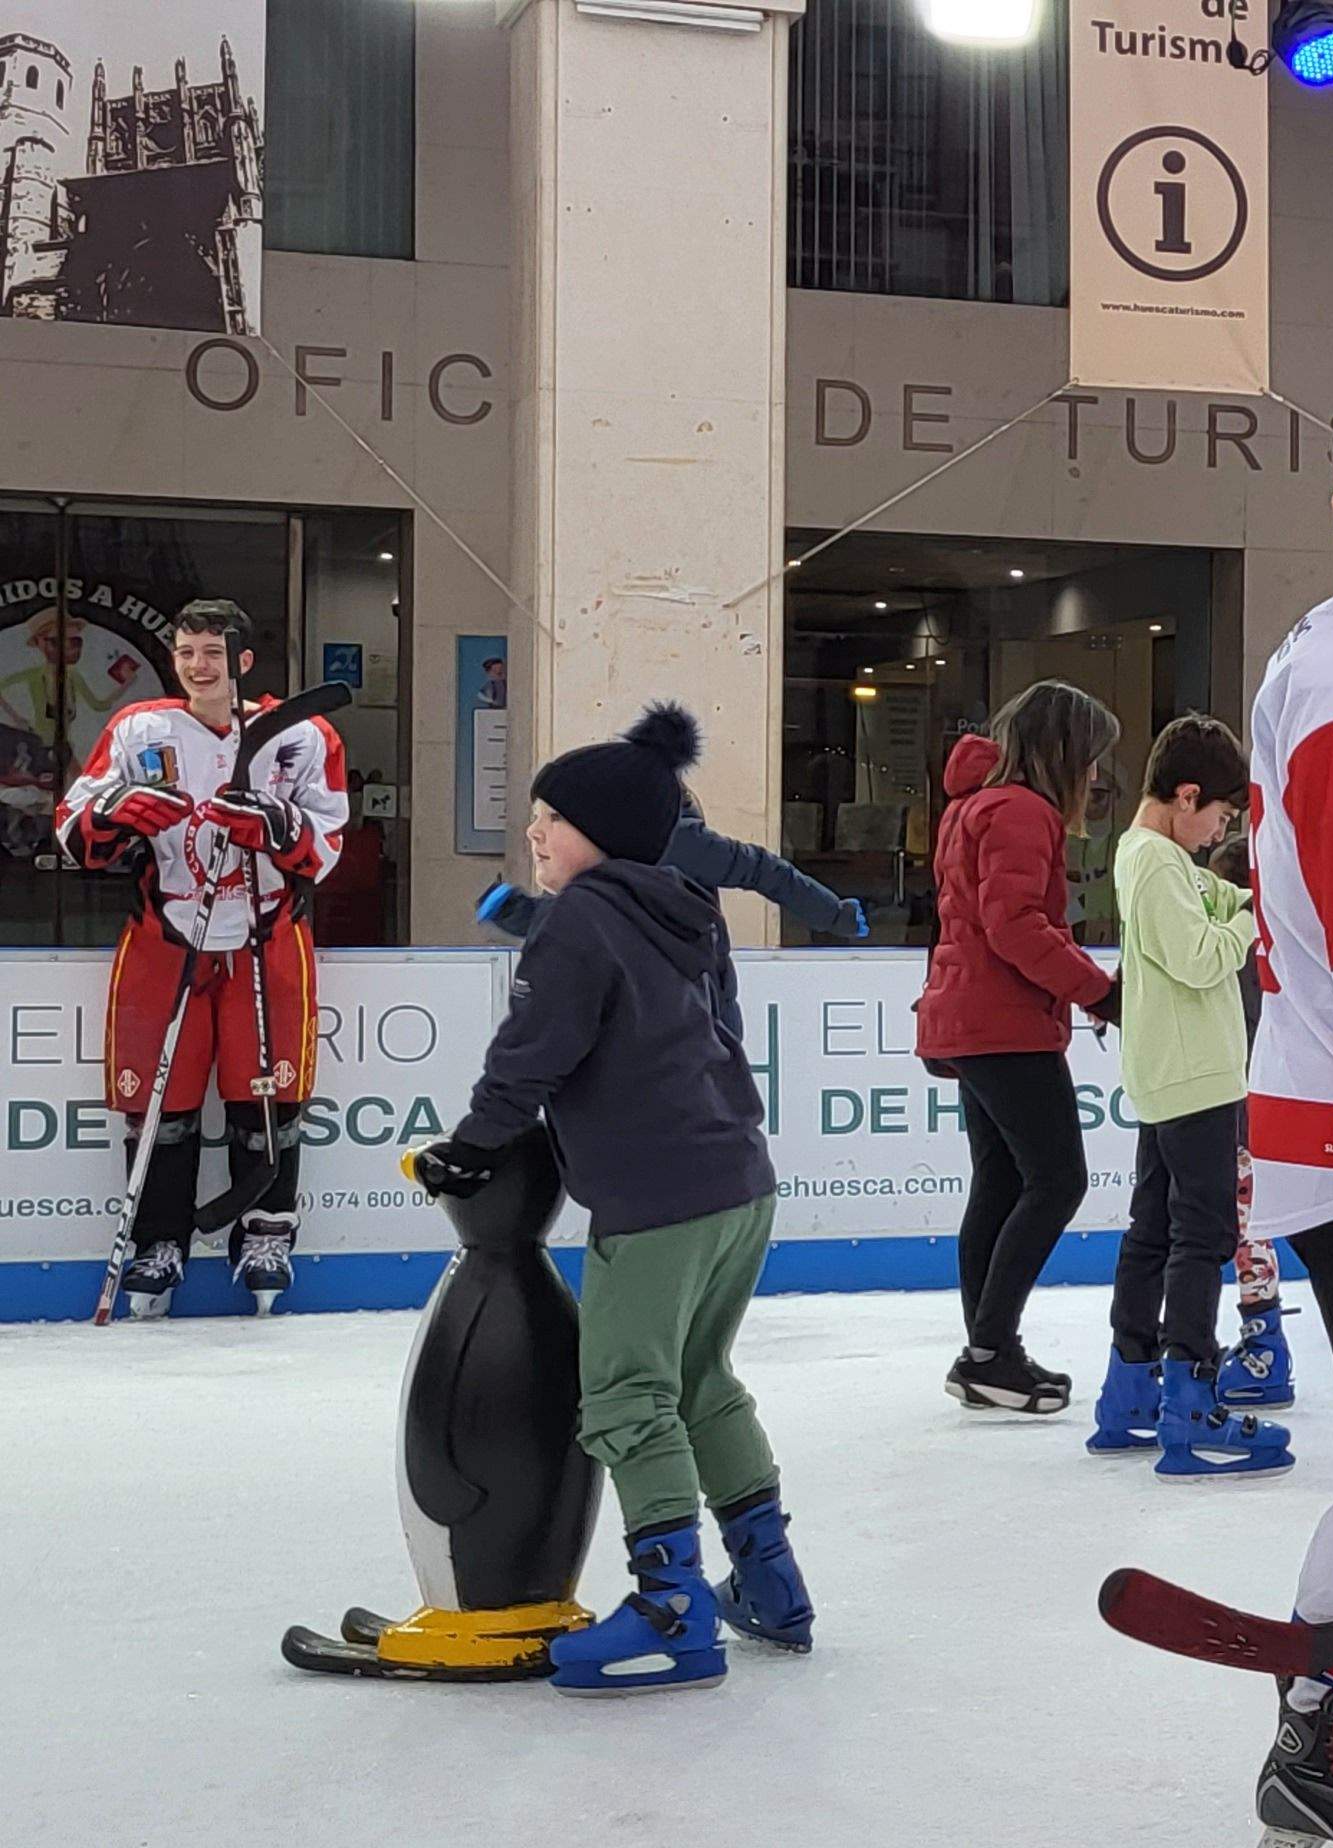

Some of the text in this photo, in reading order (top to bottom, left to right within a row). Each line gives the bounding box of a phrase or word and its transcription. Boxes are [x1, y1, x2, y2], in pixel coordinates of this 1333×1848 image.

[1091, 20, 1240, 65] Turism
[1100, 302, 1246, 320] www.huescaturismo.com
[185, 338, 1306, 473] OFIC DE TURI
[7, 1099, 112, 1151] DE
[820, 1086, 909, 1136] DE
[776, 1174, 964, 1198] ehuesca.com
[1090, 1171, 1122, 1188] 974
[321, 1191, 360, 1209] 974
[367, 1190, 405, 1208] 600
